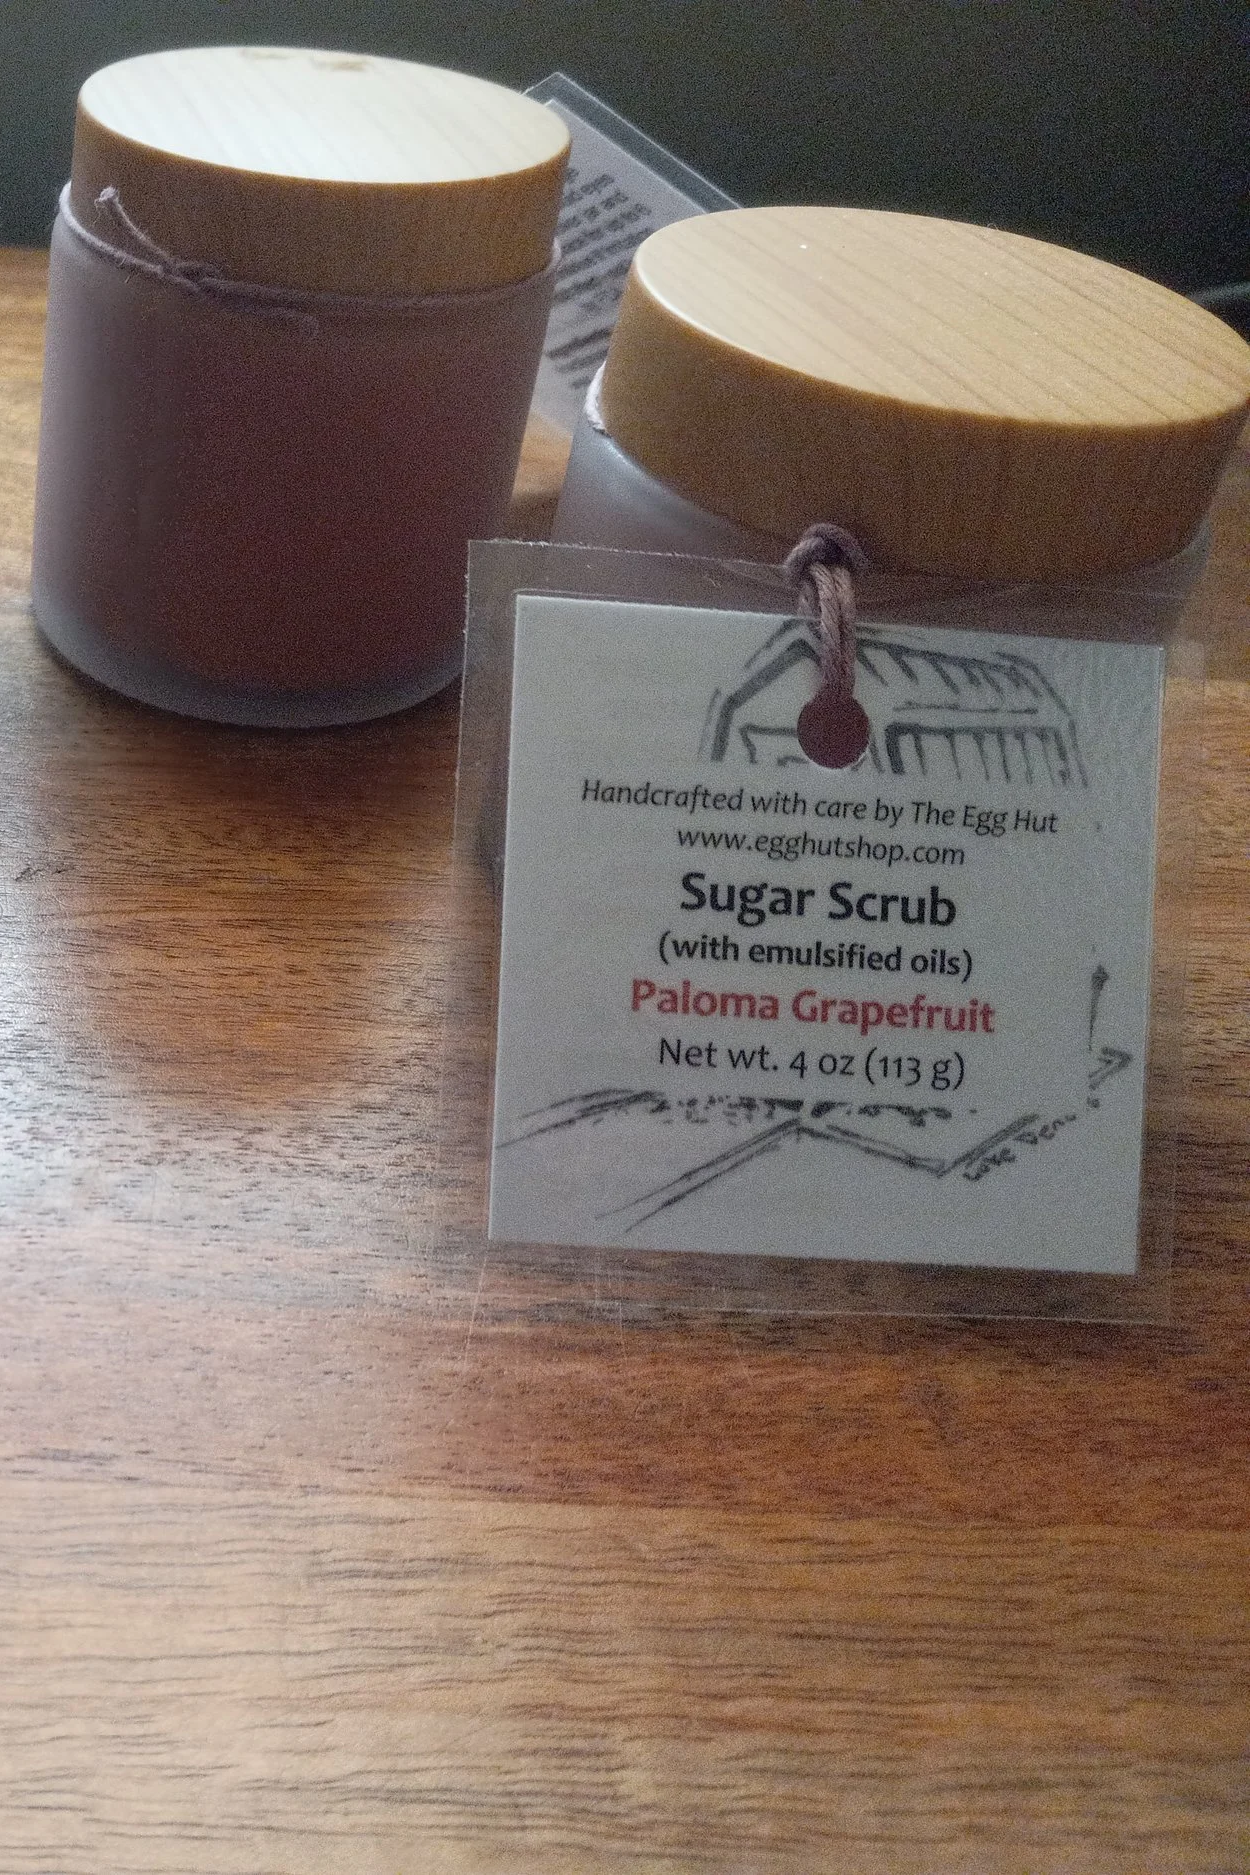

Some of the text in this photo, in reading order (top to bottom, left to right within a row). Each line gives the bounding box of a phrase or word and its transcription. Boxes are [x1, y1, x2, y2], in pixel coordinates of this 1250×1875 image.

[582, 779, 1057, 837] Handcrafted with care by The Egg Hut
[676, 827, 966, 867] www.egghutshop.com
[680, 871, 957, 927] Sugar Scrub
[658, 930, 973, 983] (with emulsified oils)
[632, 979, 995, 1035] Paloma Grapefruit
[659, 1038, 965, 1091] Net wt. 4 oz (113 g)
